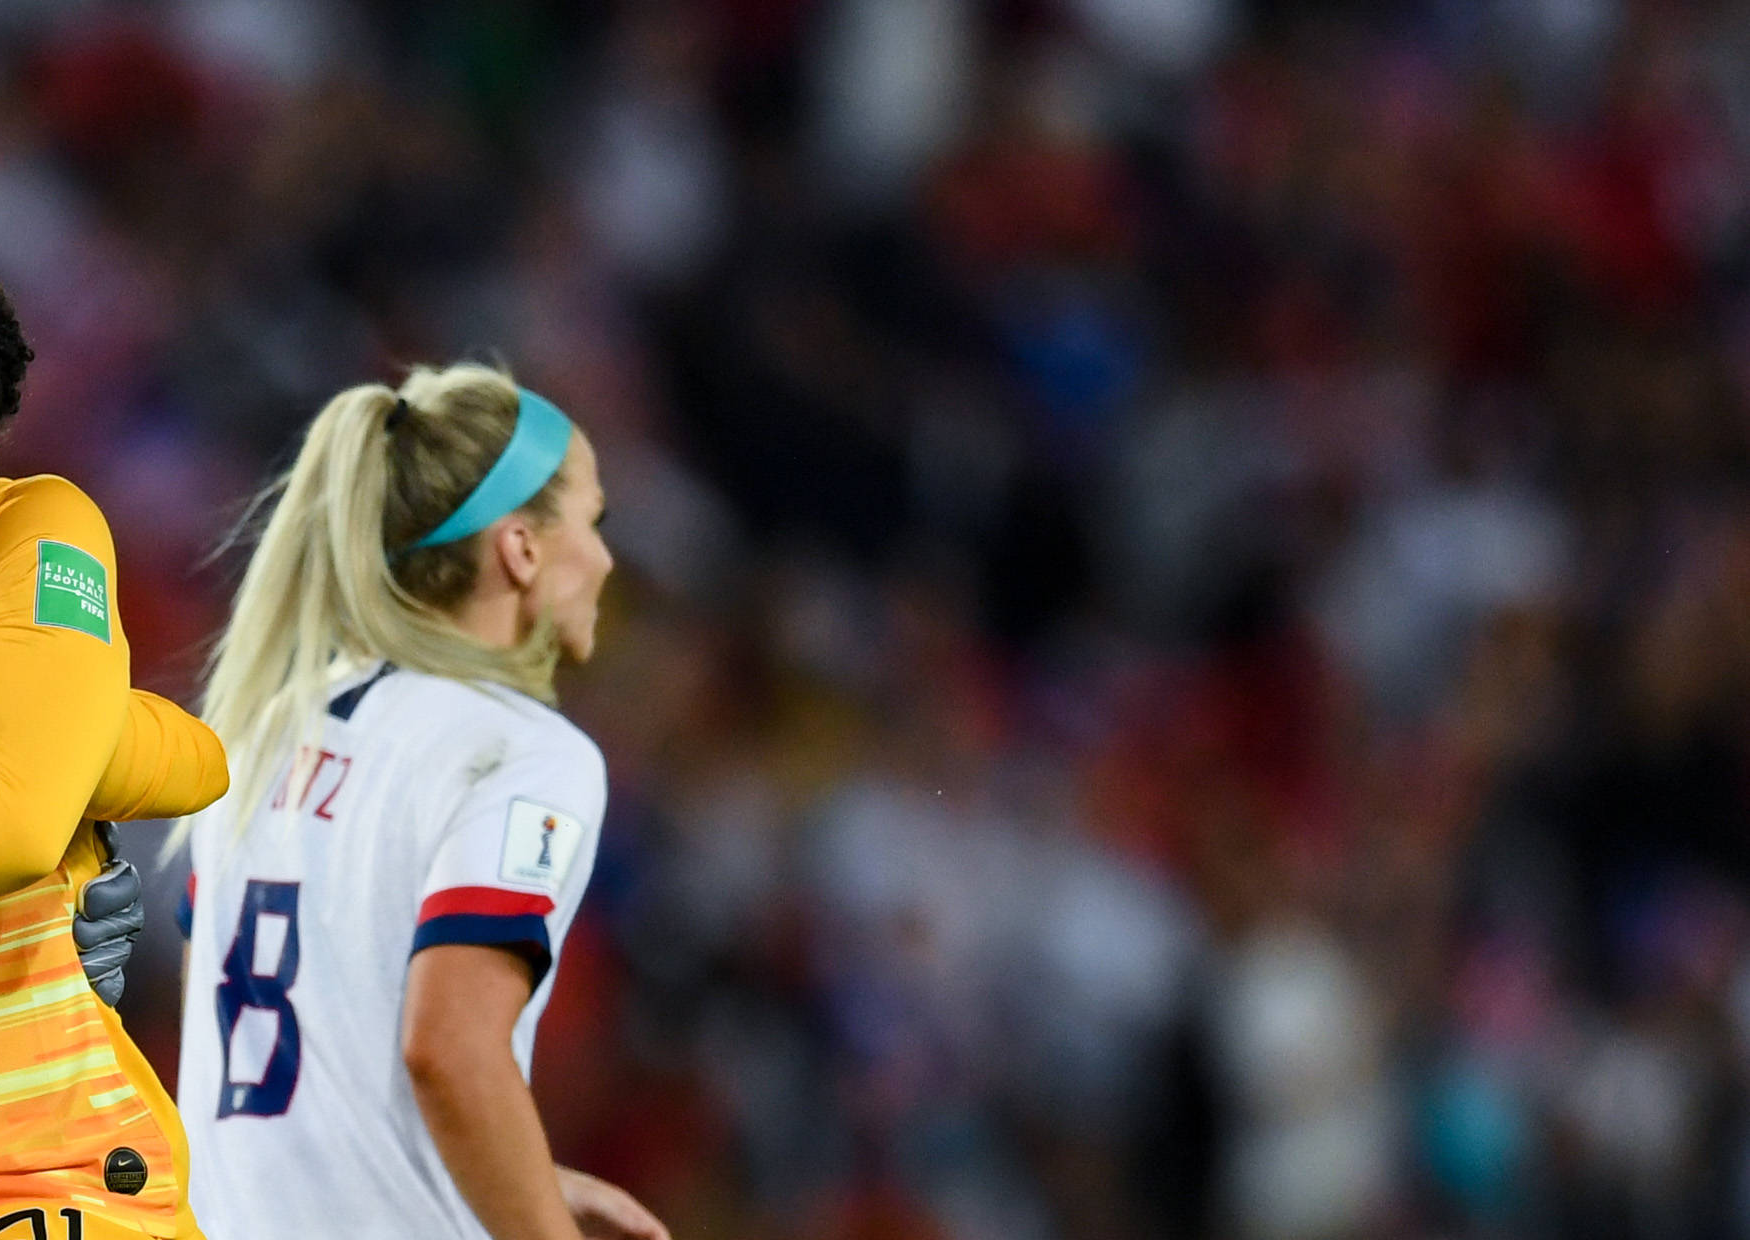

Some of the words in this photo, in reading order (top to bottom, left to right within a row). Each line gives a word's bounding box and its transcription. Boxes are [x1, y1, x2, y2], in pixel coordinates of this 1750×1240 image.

[45, 562, 104, 594] LIVING
[45, 572, 104, 603] FOOTBALL
[81, 600, 105, 620] FIFA
[216, 879, 301, 1121] 8
